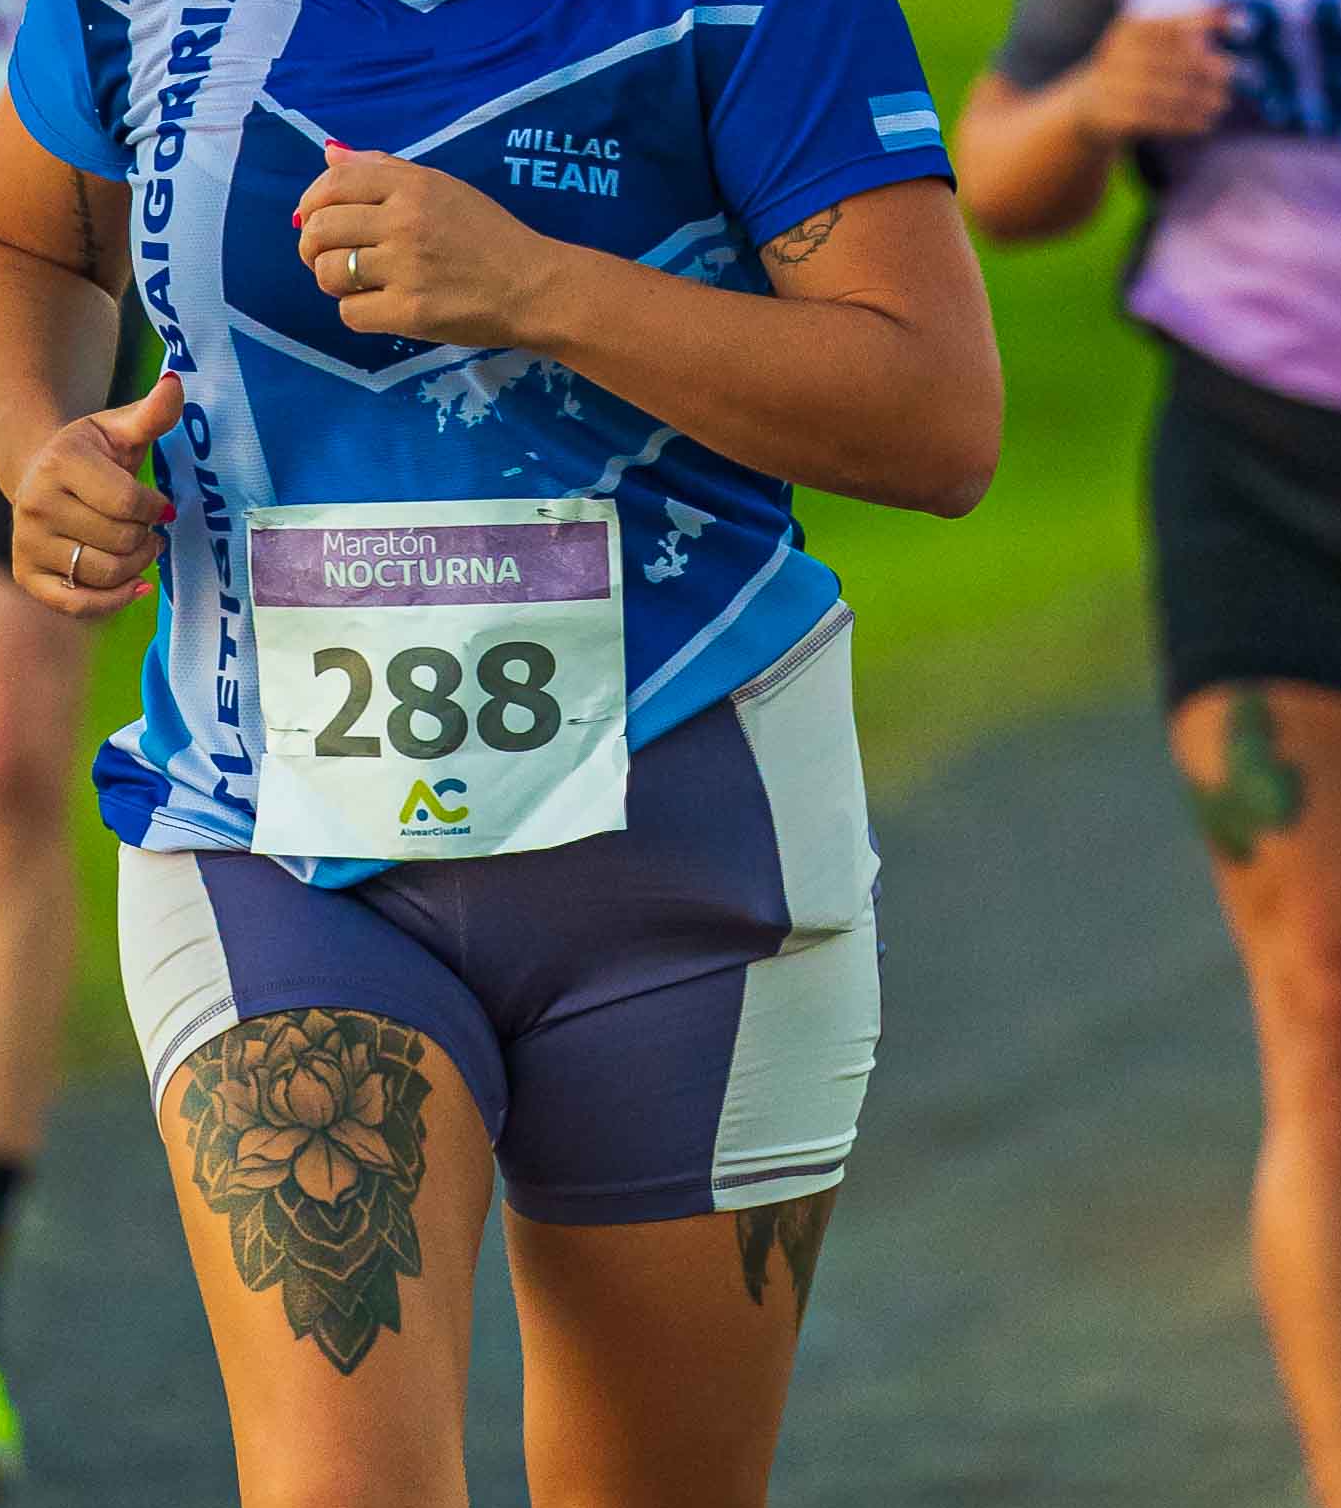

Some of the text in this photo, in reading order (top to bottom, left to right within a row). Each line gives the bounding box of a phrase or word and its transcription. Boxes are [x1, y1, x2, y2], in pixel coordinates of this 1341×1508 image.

[507, 128, 621, 161] MILLAC
[504, 156, 620, 197] TEAM
[323, 528, 436, 557] Maratón
[323, 557, 521, 588] NOCTURNA
[182, 402, 257, 821] TLETISMO
[313, 641, 562, 760] 288
